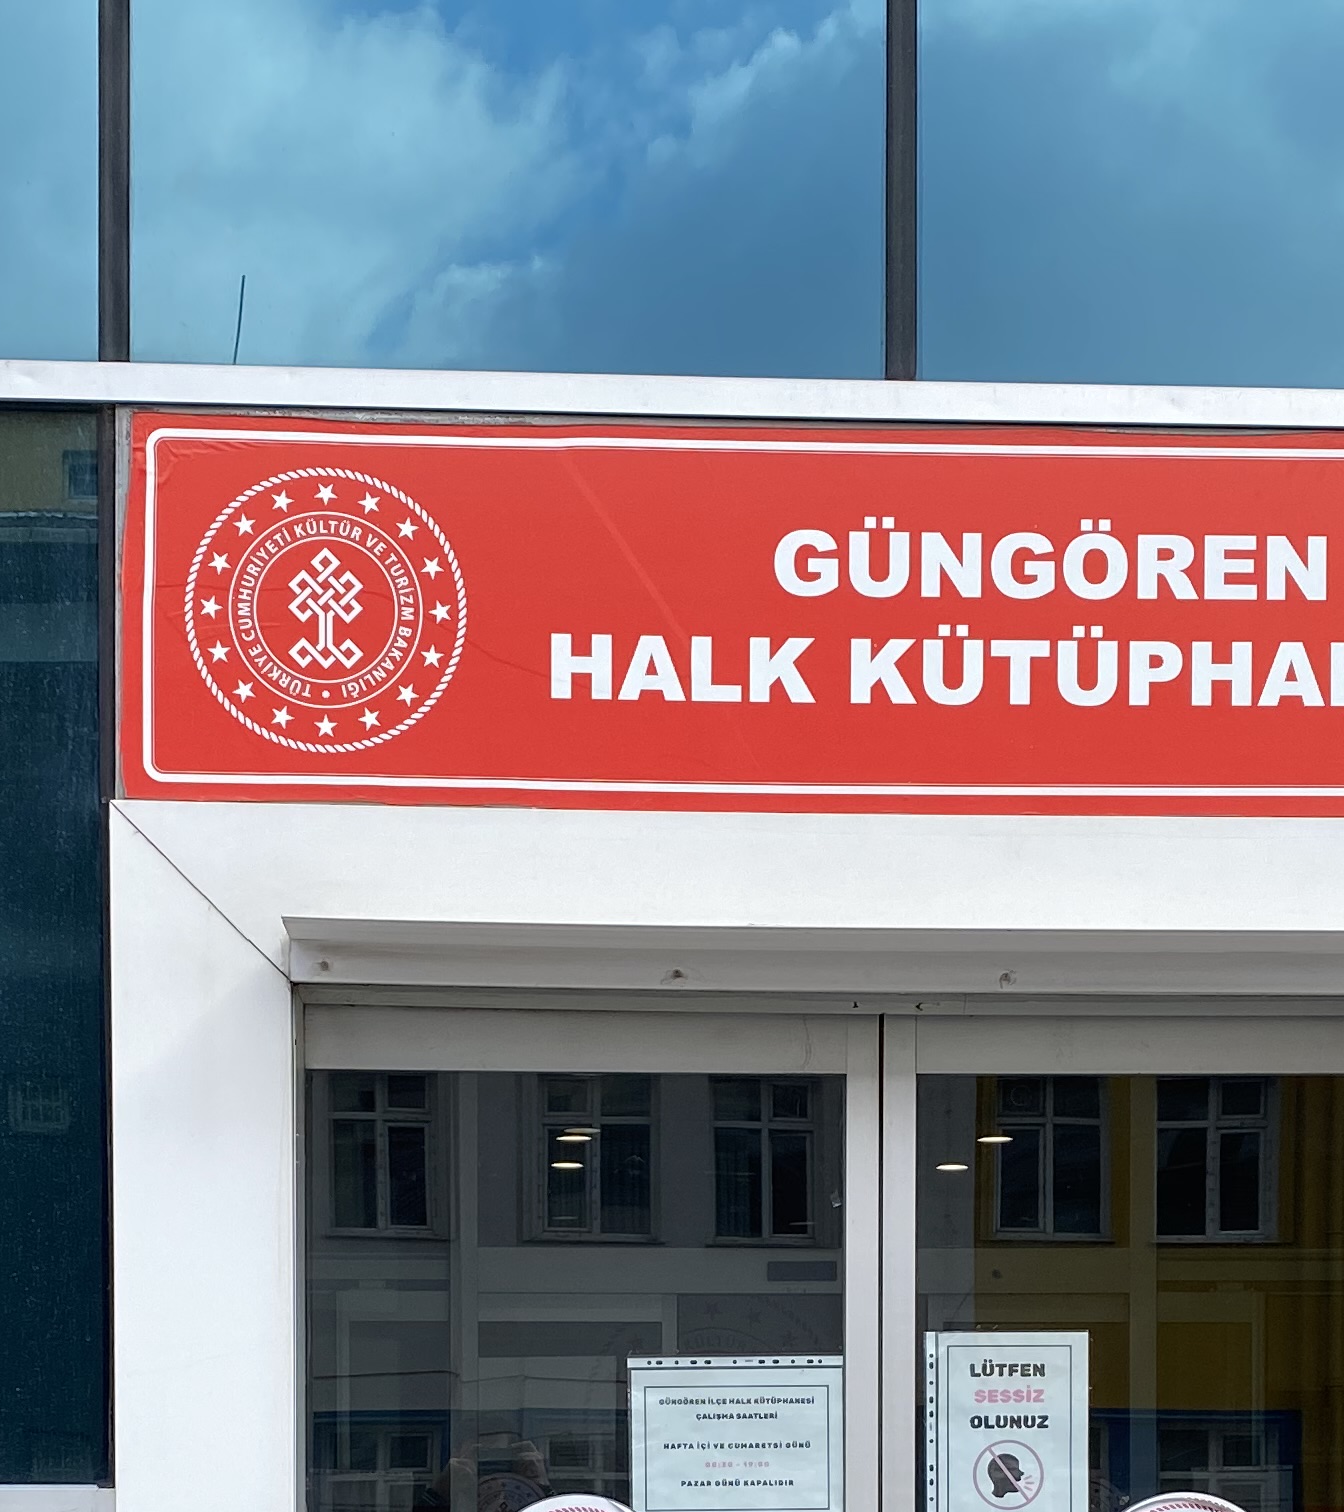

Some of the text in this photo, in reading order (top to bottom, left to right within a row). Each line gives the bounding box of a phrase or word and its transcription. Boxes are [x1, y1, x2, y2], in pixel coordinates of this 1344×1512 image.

[774, 517, 1327, 600] GÜNGÖREN
[238, 517, 415, 698] TÜRKİYE CUMHURİYETİ KÜLTÜR VE TURİZM BAKANLIĞI
[551, 633, 815, 703] HALK
[969, 1359, 1045, 1377] LÜTFEN
[659, 1397, 706, 1405] GÜNGÖREN
[708, 1397, 727, 1406] İLÇE
[754, 1396, 815, 1404] KÜTÜPHANESİ
[974, 1385, 1045, 1403] SESSİZ
[736, 1411, 778, 1419] SAATLERİ
[970, 1415, 1049, 1429] OLUNUZ
[697, 1441, 711, 1450] İÇİ
[786, 1441, 810, 1449] GÜNÜ
